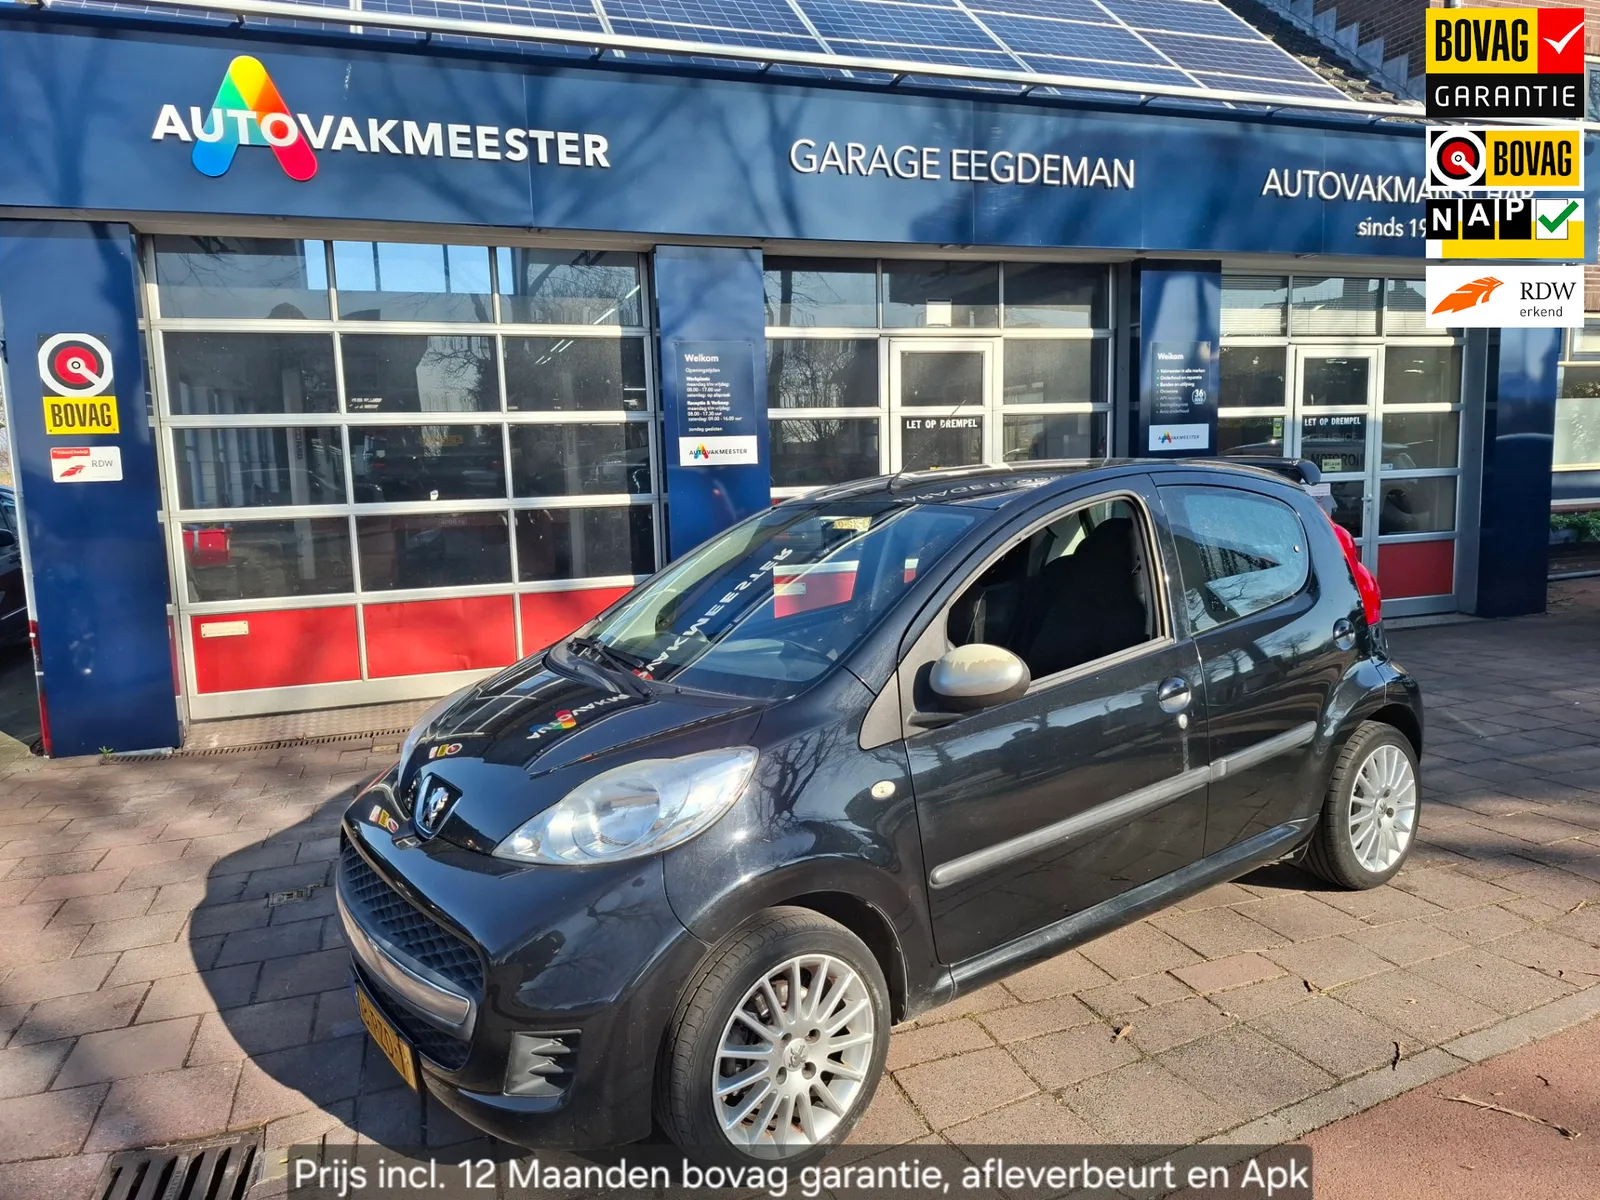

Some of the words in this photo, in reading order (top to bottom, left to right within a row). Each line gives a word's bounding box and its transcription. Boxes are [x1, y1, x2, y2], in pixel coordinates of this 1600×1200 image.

[151, 104, 610, 168] AUTOVAKMEESTER
[789, 139, 941, 180] GARAGE
[951, 148, 1135, 189] EEGDEMAN
[1357, 216, 1404, 237] sinds
[684, 353, 719, 362] Welkom
[1157, 352, 1184, 360] Welkom
[1194, 388, 1203, 397] 36
[50, 403, 112, 427] BOVAG
[906, 420, 921, 429] LET
[925, 420, 937, 429] OP
[940, 418, 978, 428] DREMPEL
[1304, 418, 1317, 426] LET
[1319, 417, 1329, 425] OP
[1331, 416, 1361, 425] DREMPEL
[91, 459, 113, 467] RDW
